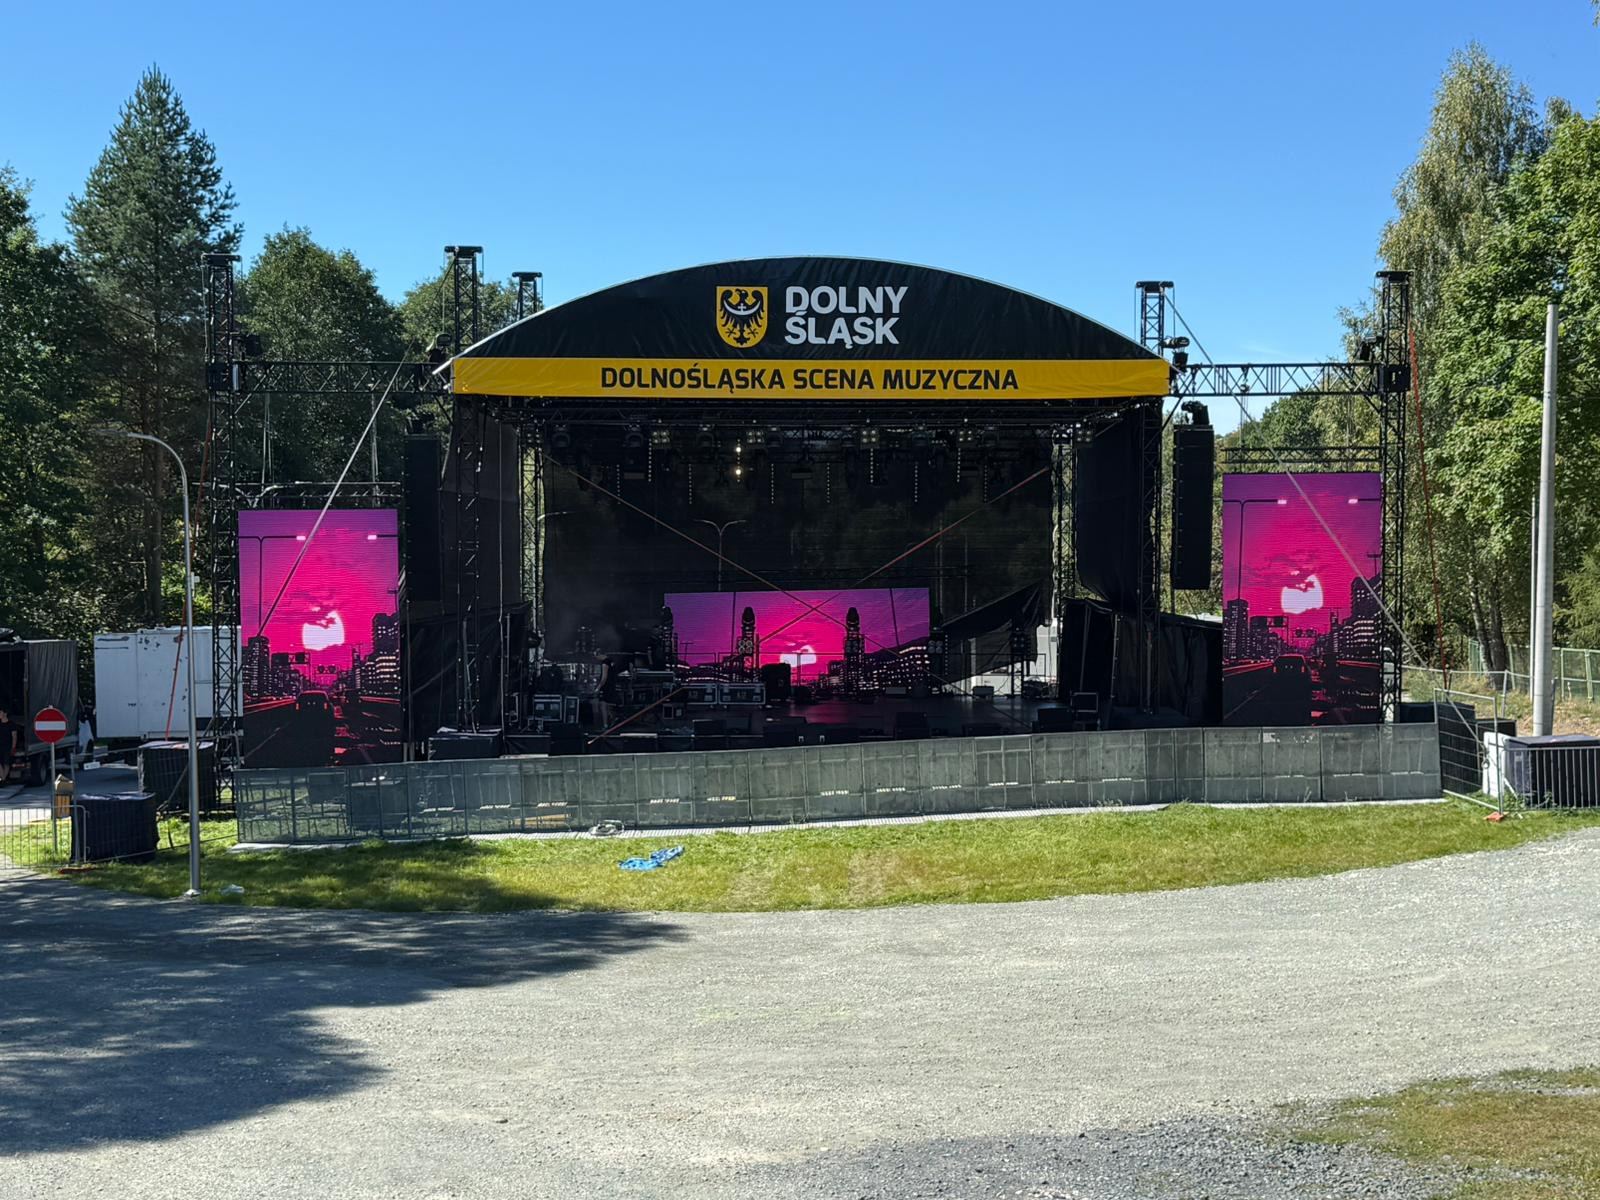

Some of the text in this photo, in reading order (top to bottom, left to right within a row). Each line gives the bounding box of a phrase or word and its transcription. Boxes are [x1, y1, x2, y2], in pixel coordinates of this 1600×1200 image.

[785, 286, 909, 313] DOLNY
[784, 310, 900, 349] ŚLĄSK
[601, 363, 1019, 394] DOLNOŚLĄSKA SCENA MUZYCZNA
